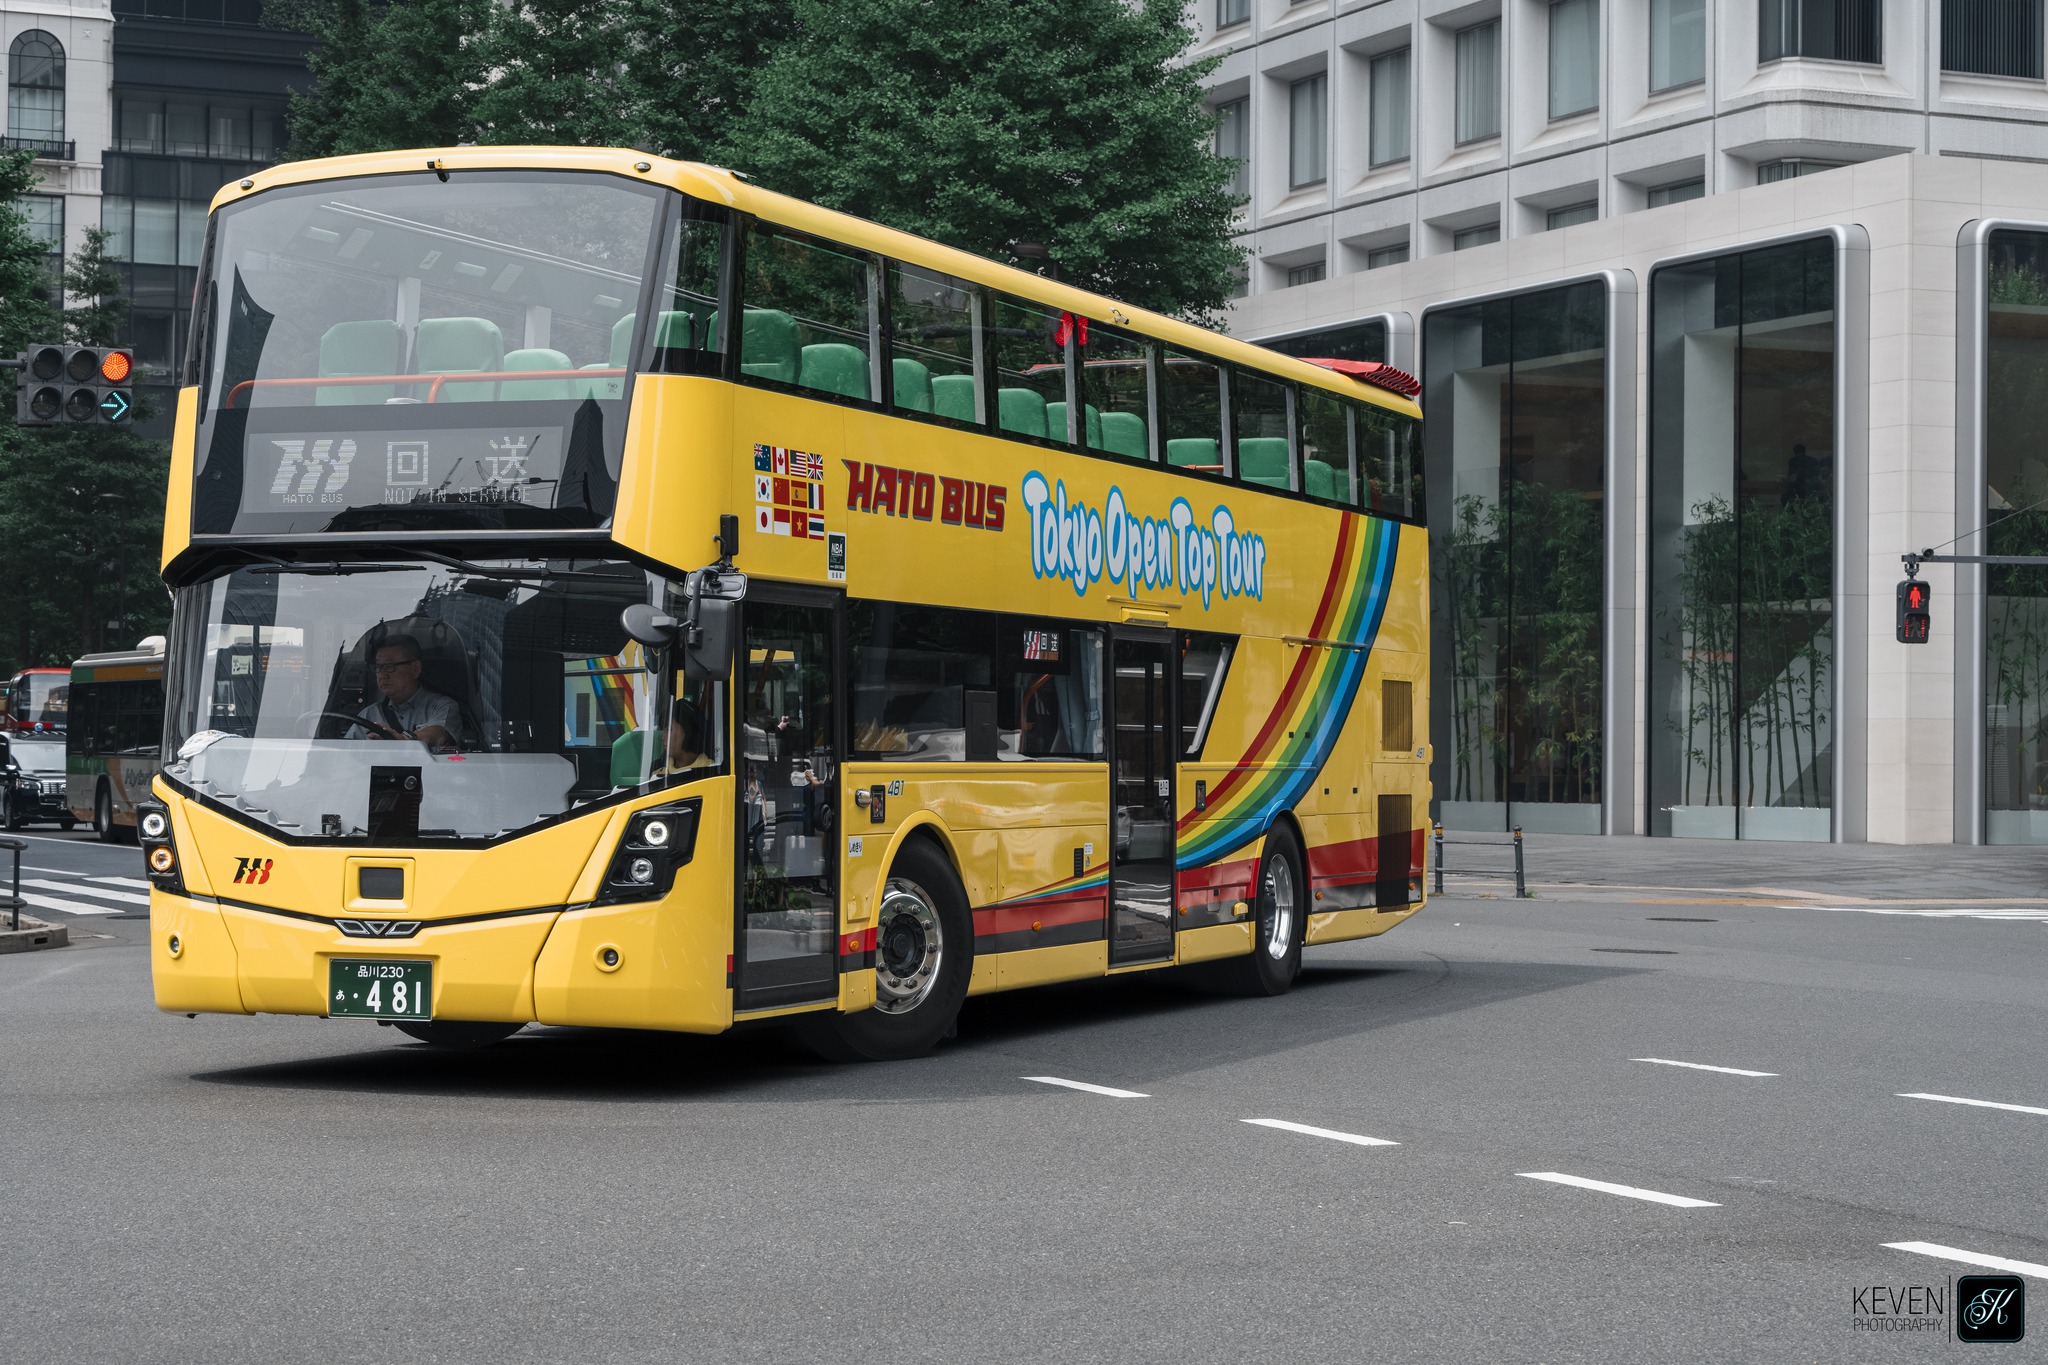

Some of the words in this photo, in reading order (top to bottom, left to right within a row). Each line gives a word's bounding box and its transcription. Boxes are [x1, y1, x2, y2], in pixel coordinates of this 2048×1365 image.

[282, 494, 314, 504] HATO
[321, 493, 343, 503] BUS
[385, 487, 415, 504] NOT
[428, 487, 446, 504] IN
[841, 458, 935, 522] HATO
[938, 475, 1007, 532] BUS
[1022, 470, 1103, 597] Tokyo
[1104, 485, 1173, 600] Open
[1170, 496, 1216, 611] Top
[1212, 504, 1265, 601] Tour
[887, 780, 905, 796] 481
